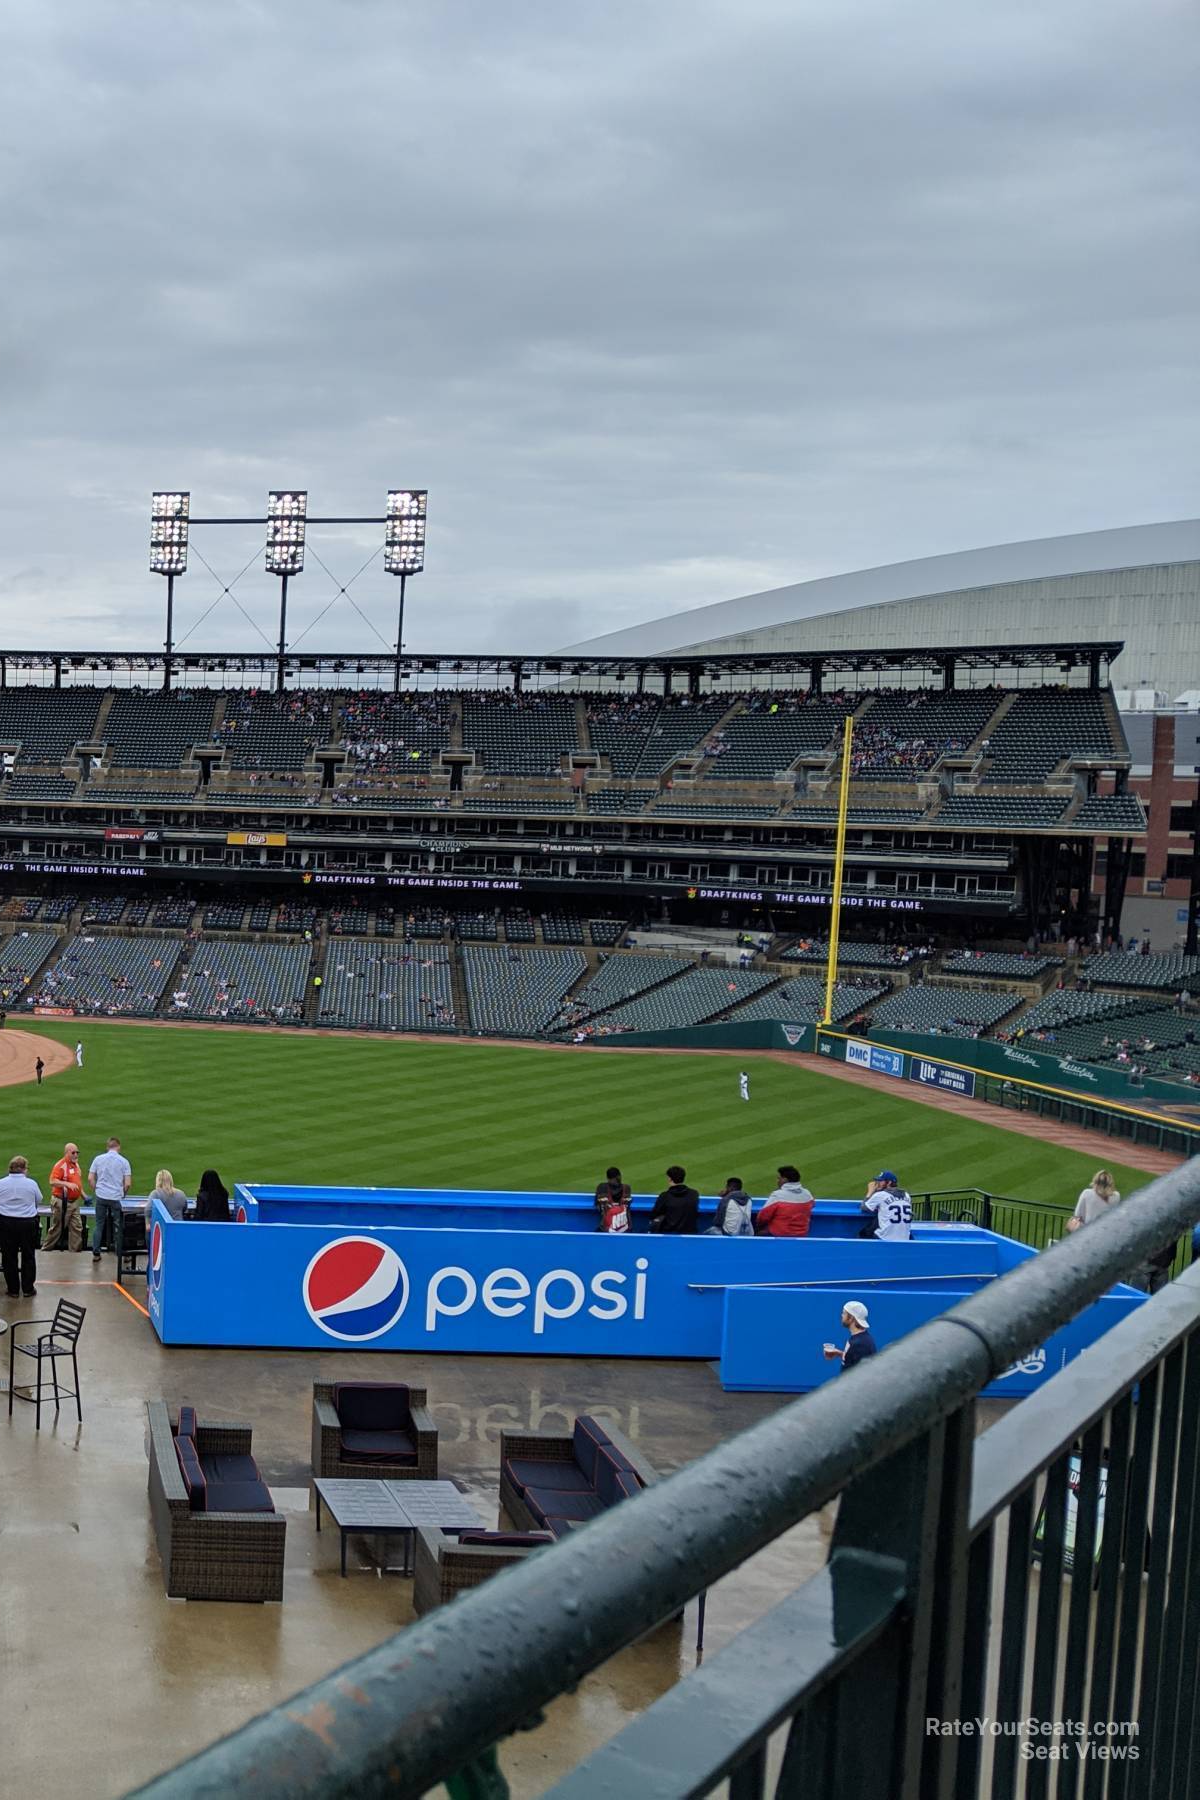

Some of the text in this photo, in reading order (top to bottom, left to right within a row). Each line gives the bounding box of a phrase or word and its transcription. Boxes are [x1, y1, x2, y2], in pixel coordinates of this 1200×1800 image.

[420, 839, 470, 848] CHAMPIONS
[25, 864, 41, 872] THE
[43, 864, 68, 873] GAME
[70, 865, 99, 874] INSIDE
[101, 867, 117, 875] THE
[315, 875, 376, 884] DRAFTKINGS
[388, 877, 405, 885] THE
[408, 878, 435, 886] GAME
[437, 879, 469, 888] INSIDE
[471, 880, 489, 888] THE
[700, 890, 763, 901] DRAFTKINGS
[775, 893, 794, 902] THE
[797, 894, 826, 904] GAME
[829, 896, 864, 906] ISIDE
[867, 898, 887, 908] THE
[849, 1046, 869, 1062] DMC
[920, 1061, 937, 1081] Lite
[939, 1077, 952, 1087] LIGHT
[889, 1204, 914, 1224] 35
[425, 1257, 649, 1334] pepsi
